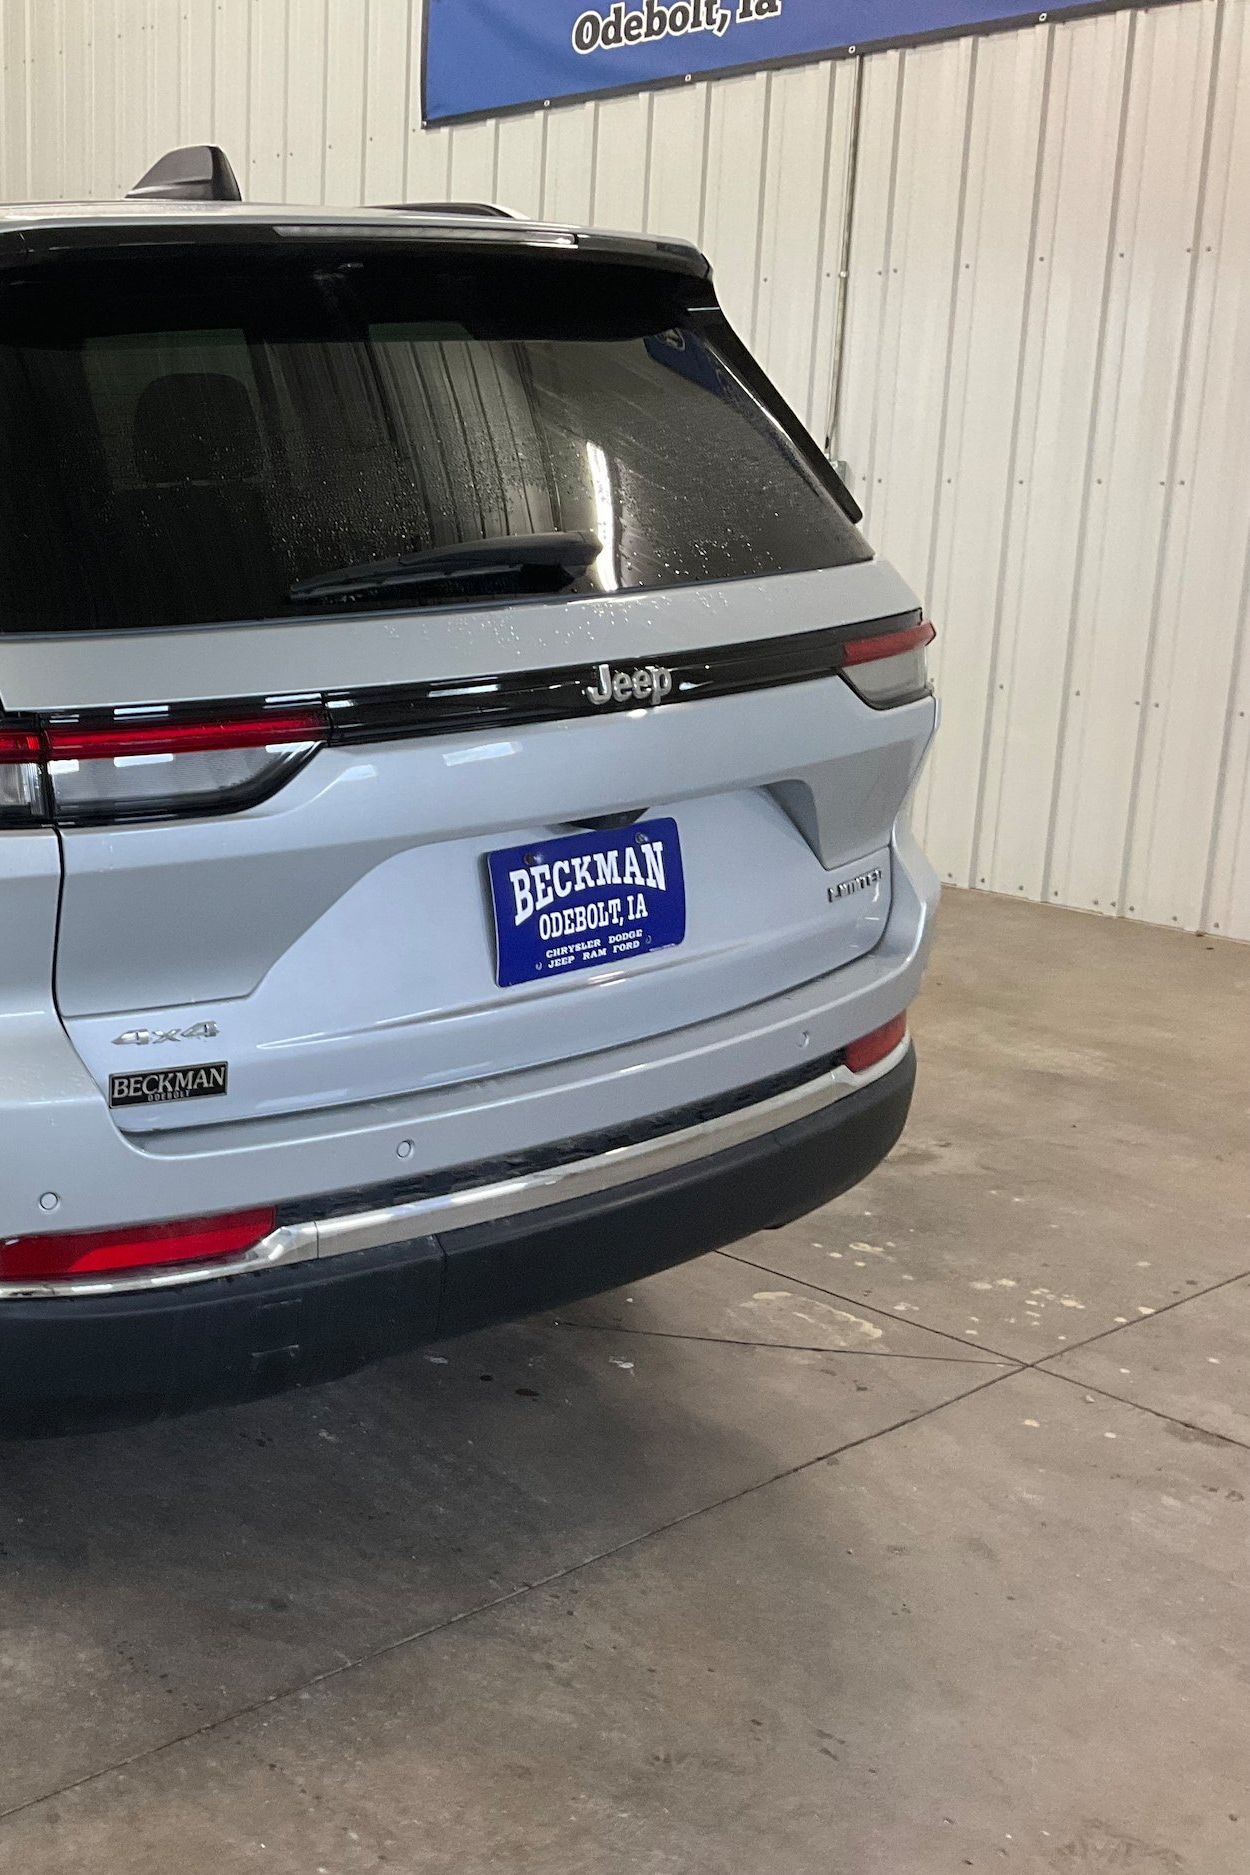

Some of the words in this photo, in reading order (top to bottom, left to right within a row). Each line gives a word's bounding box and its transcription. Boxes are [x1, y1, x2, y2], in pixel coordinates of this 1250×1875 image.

[572, 0, 731, 54] Odebolt,
[586, 663, 672, 706] Jeep
[509, 841, 666, 926] BECKMAN
[539, 899, 624, 940] ODEBOLT,
[627, 893, 648, 920] IA
[546, 938, 601, 959] CHRYSLER
[608, 929, 643, 944] DODGE
[548, 955, 575, 969] JEEP
[582, 948, 607, 961] RAM
[612, 940, 640, 954] FORD
[113, 1067, 225, 1099] BECKMAN
